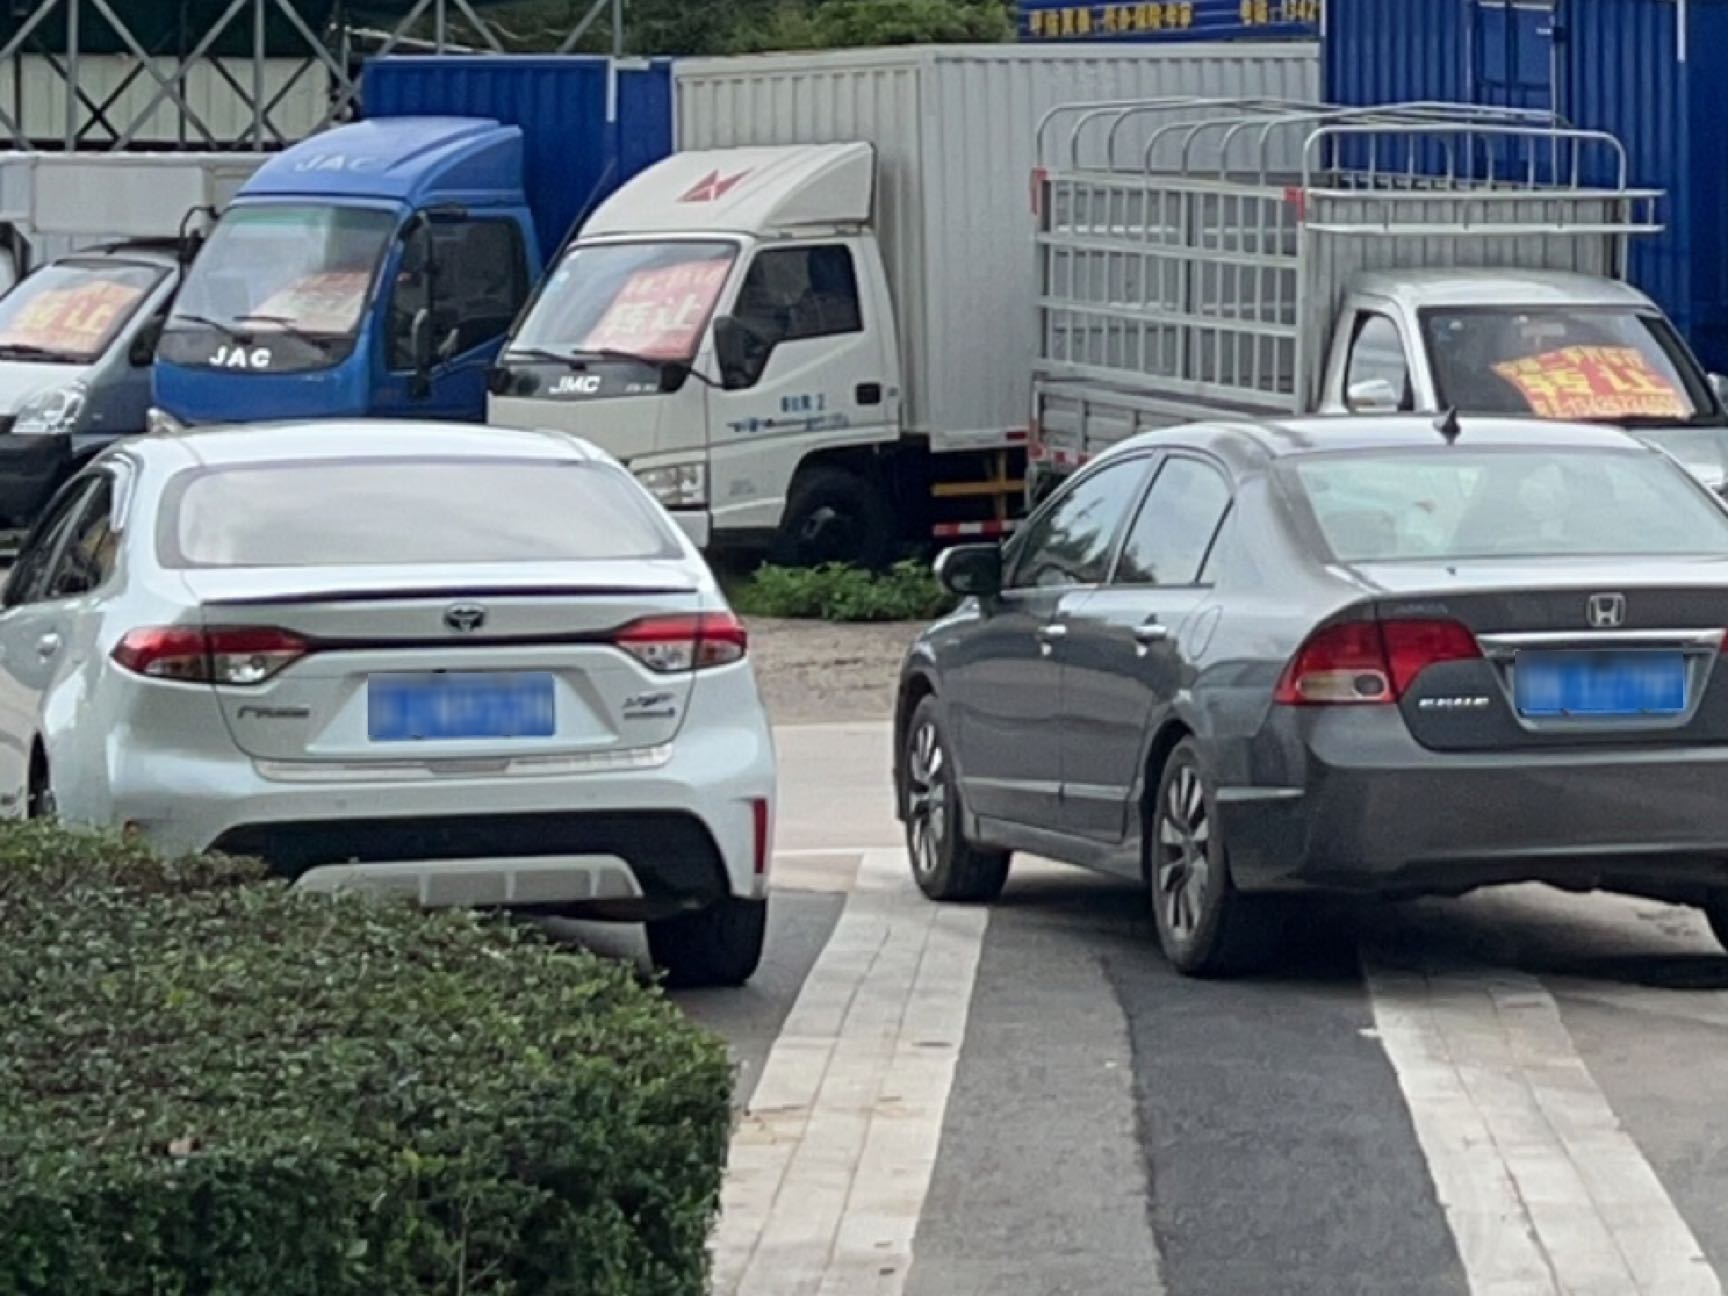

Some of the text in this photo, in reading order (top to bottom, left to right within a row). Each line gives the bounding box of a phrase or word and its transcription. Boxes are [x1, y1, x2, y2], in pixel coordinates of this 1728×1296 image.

[294, 153, 376, 173] JAC
[209, 345, 272, 368] JAC
[549, 375, 601, 394] JMC
